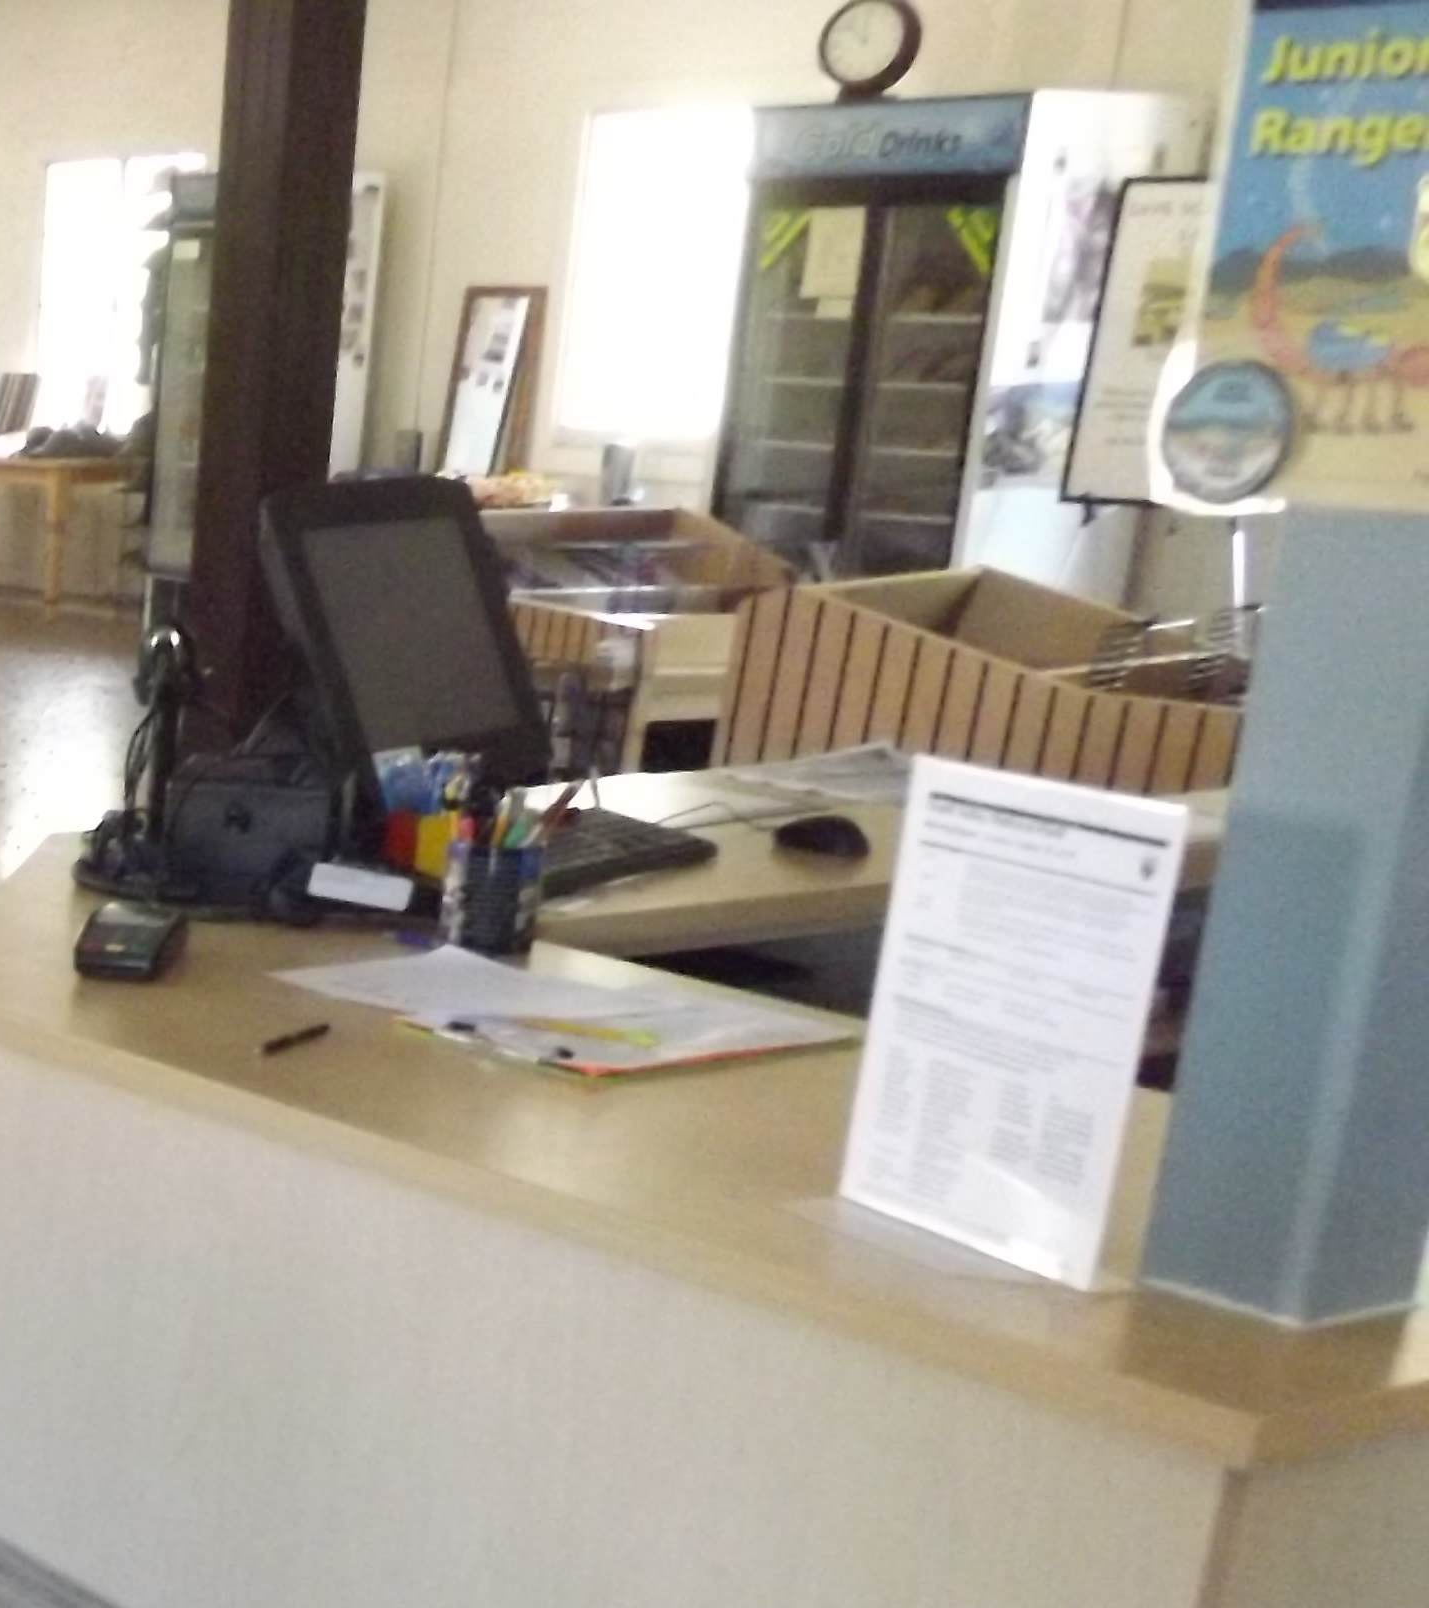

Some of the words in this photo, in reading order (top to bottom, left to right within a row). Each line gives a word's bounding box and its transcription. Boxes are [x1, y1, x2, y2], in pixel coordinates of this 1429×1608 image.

[795, 120, 881, 162] Cold
[879, 128, 963, 159] Drinks
[1249, 106, 1429, 169] Range
